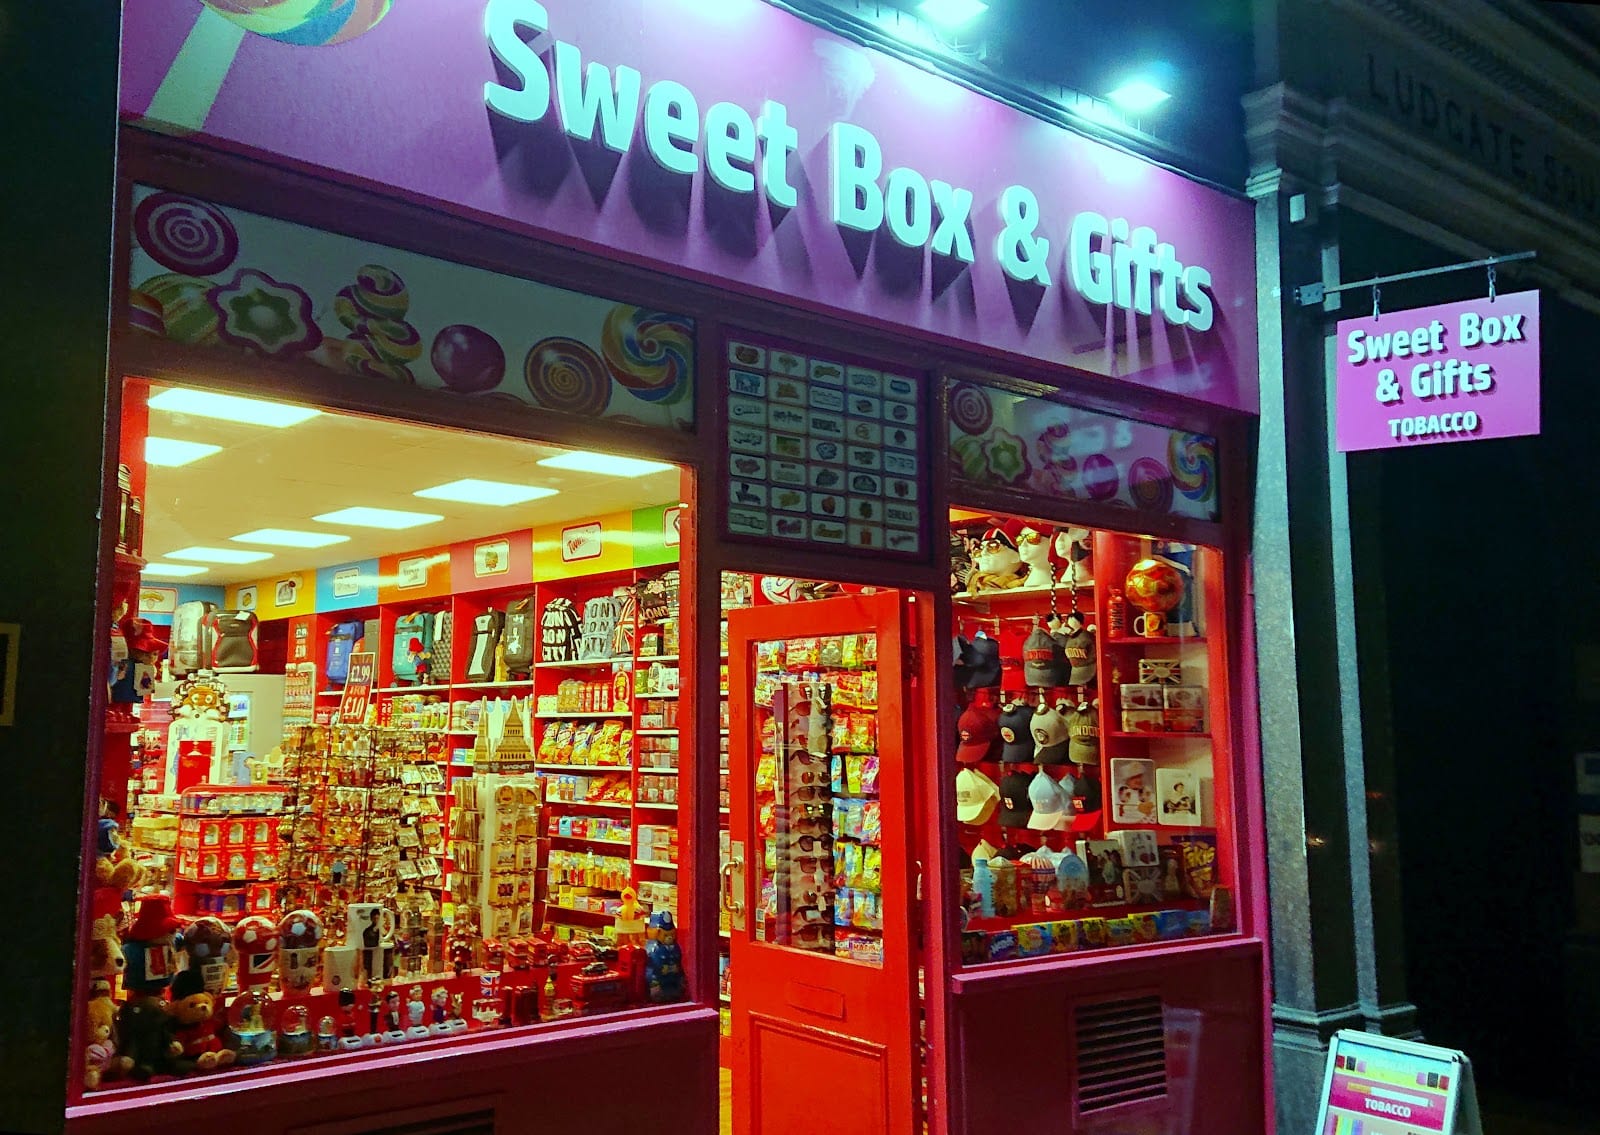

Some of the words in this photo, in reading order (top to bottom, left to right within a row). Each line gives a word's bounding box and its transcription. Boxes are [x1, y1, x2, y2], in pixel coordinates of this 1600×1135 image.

[1367, 53, 1527, 180] LUDGATE
[484, 0, 797, 208] Sweet
[831, 122, 974, 264] Box
[997, 185, 1052, 286] &
[1070, 211, 1213, 332] Gifts
[1347, 320, 1444, 364] Sweet
[1459, 312, 1522, 347] Box
[1375, 368, 1400, 403] &
[1411, 358, 1492, 398] Gifts
[1388, 410, 1477, 437] TOBACCO
[343, 696, 365, 719] £10
[1364, 1097, 1412, 1118] TOBACCO
